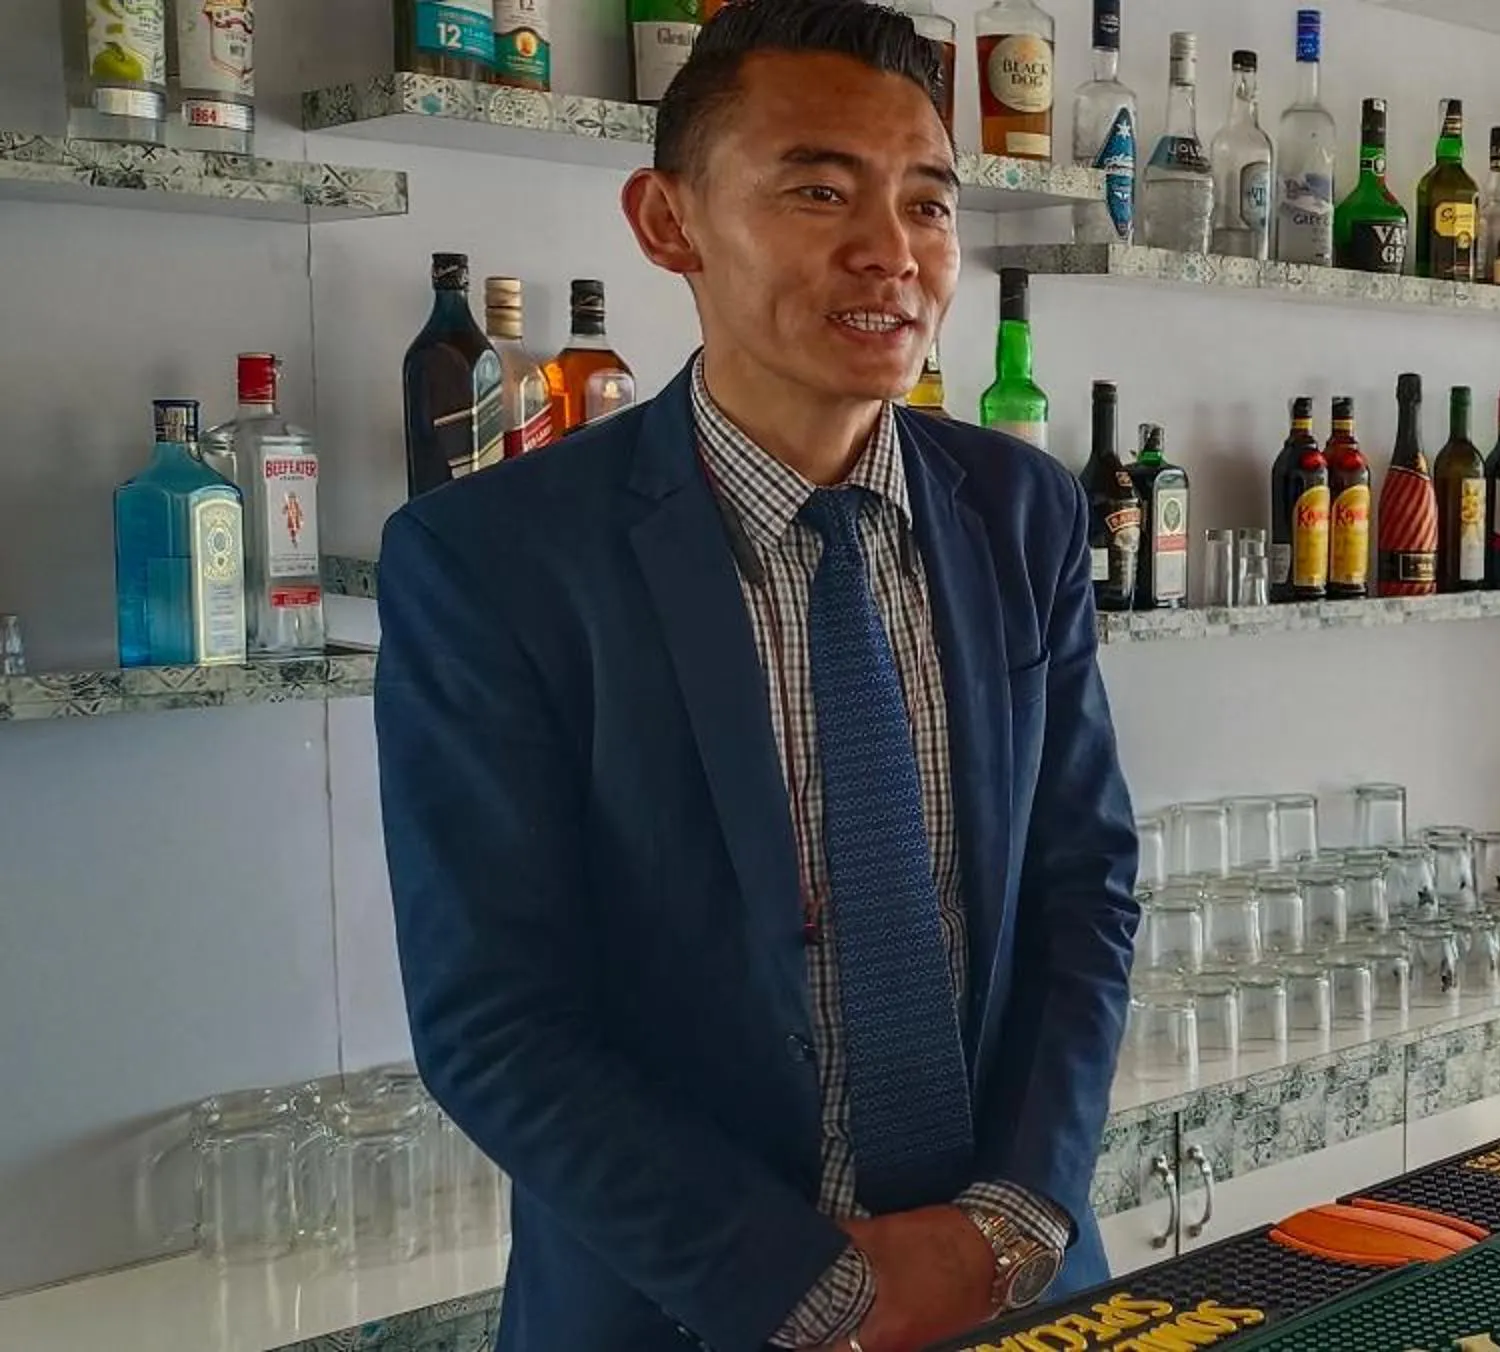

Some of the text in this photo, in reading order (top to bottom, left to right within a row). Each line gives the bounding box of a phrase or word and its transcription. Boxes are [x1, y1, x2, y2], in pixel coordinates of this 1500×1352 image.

[436, 22, 462, 48] 12
[1002, 58, 1049, 76] BLACK
[1381, 246, 1405, 263] 69
[265, 460, 317, 479] BEEFEATER
